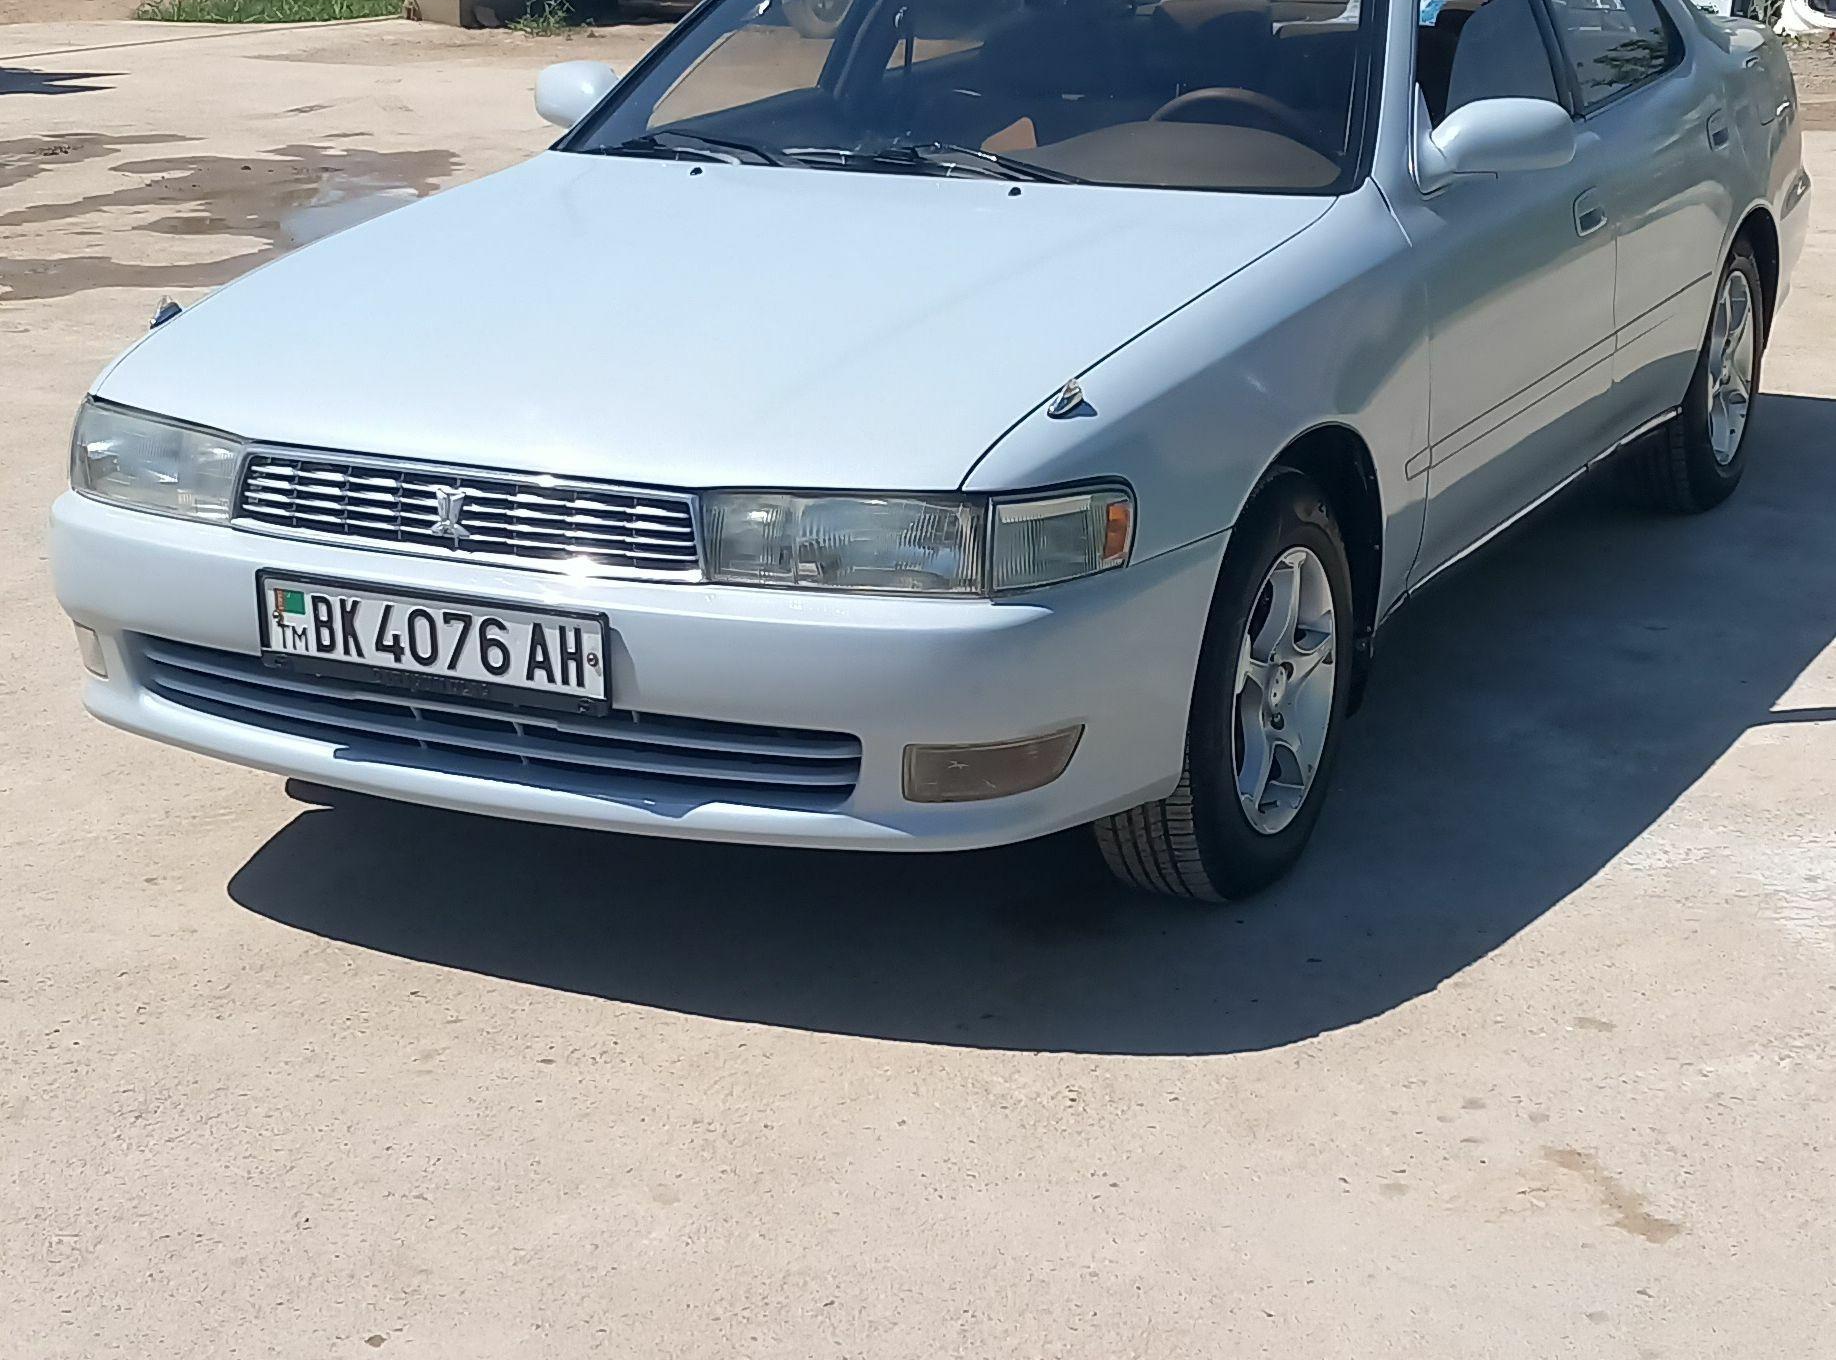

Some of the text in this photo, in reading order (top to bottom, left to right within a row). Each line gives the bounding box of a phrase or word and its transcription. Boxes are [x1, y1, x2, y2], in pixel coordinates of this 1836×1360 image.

[280, 622, 309, 653] TM
[311, 593, 366, 659] BK
[375, 603, 511, 677] 4076
[525, 622, 586, 688] AH
